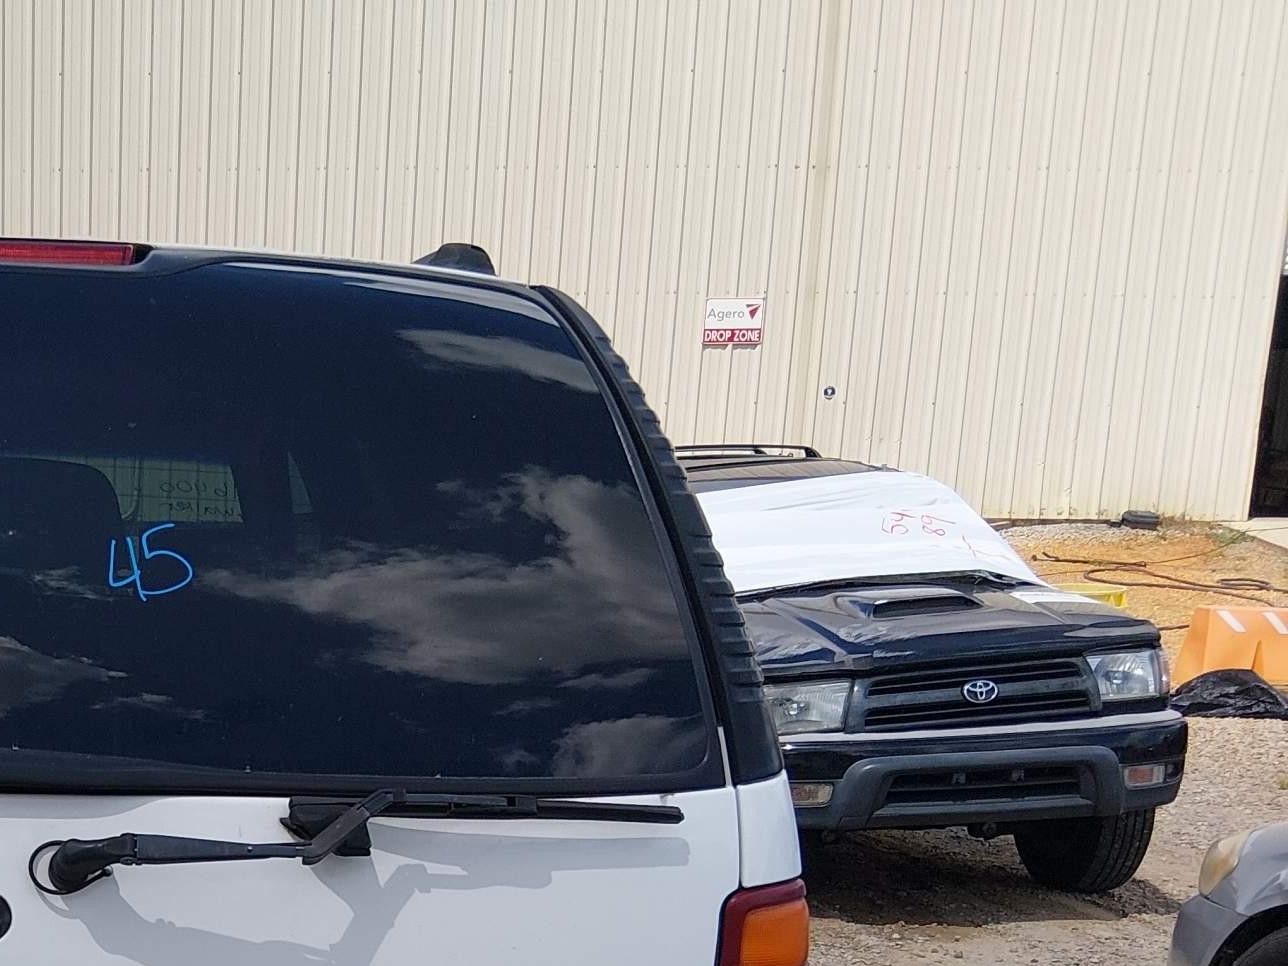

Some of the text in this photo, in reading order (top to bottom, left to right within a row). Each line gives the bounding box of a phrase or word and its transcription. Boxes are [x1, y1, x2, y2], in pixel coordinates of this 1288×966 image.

[707, 308, 745, 321] Agero
[704, 330, 761, 342] DROP ZONE
[881, 509, 916, 534] 54
[920, 514, 957, 536] 89
[109, 523, 193, 602] 45
